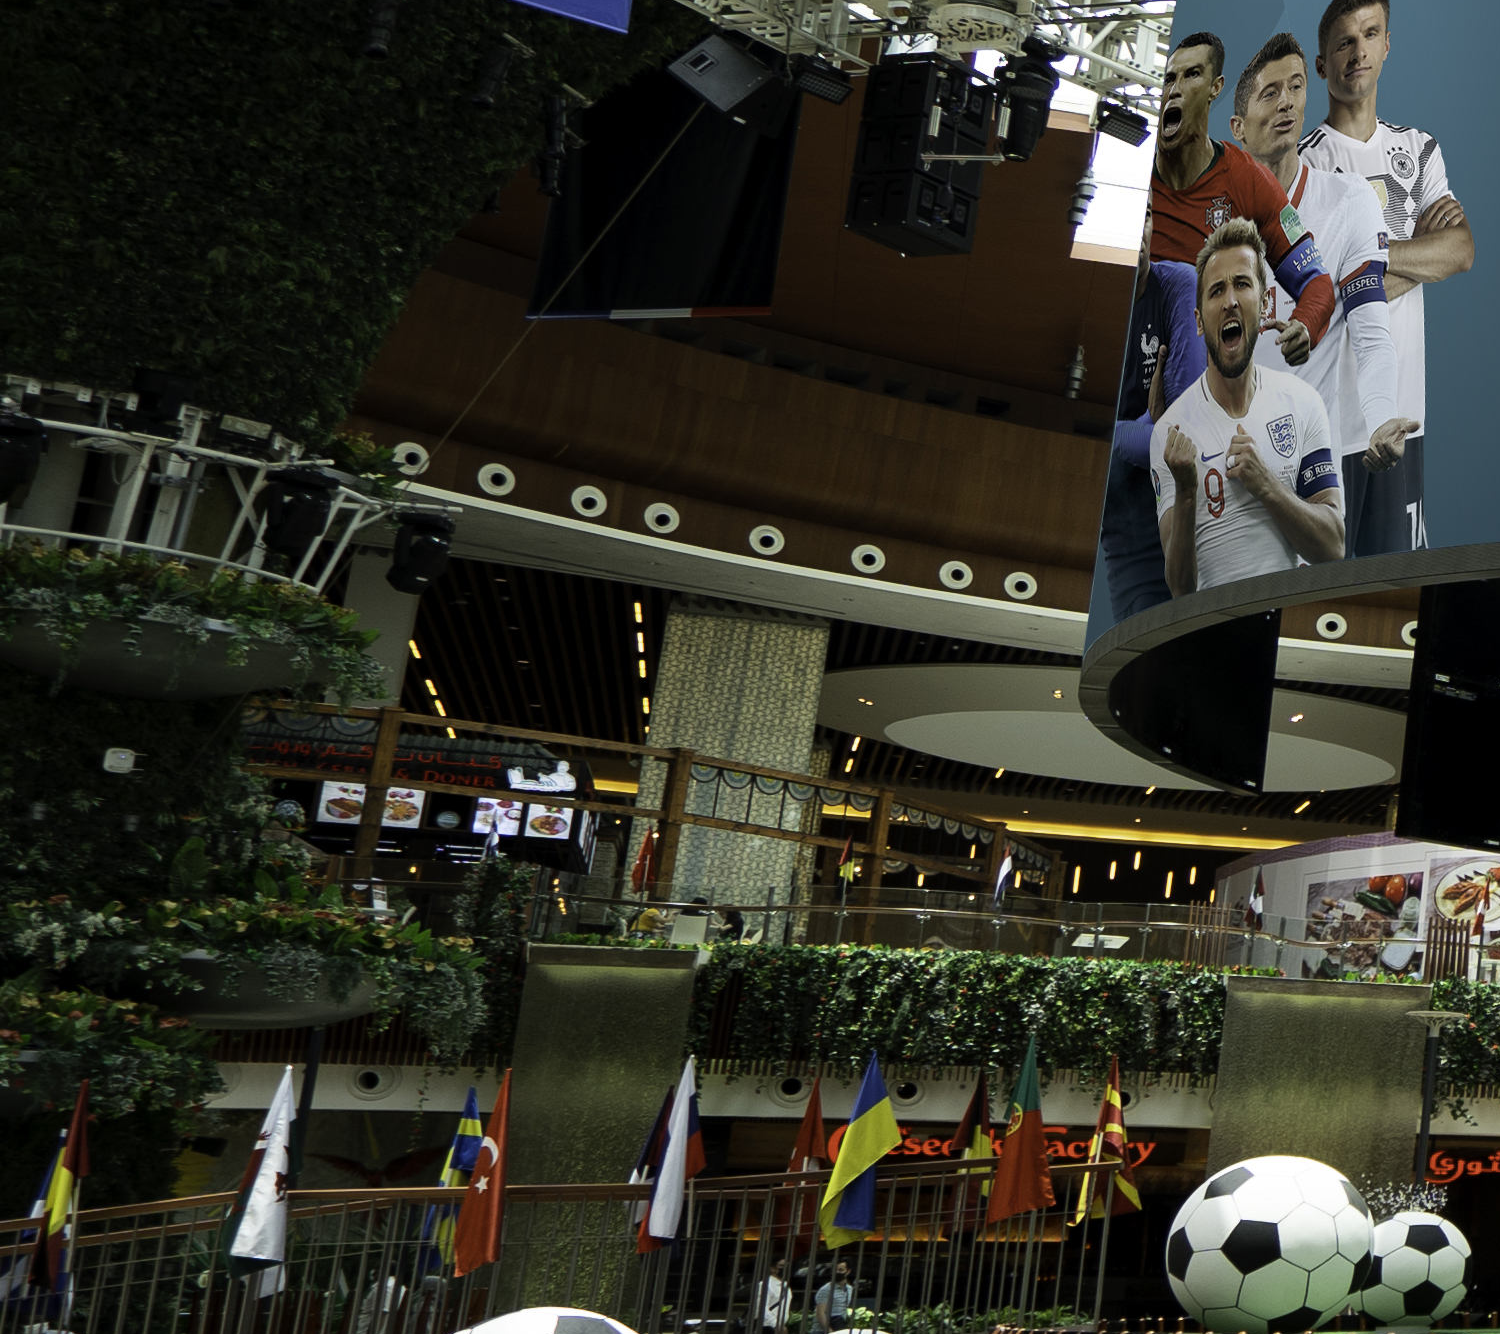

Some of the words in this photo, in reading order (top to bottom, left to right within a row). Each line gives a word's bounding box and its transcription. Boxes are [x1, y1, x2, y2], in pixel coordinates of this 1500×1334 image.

[1346, 276, 1380, 295] RESPECT
[1203, 467, 1225, 520] 9
[422, 769, 496, 789] DONER
